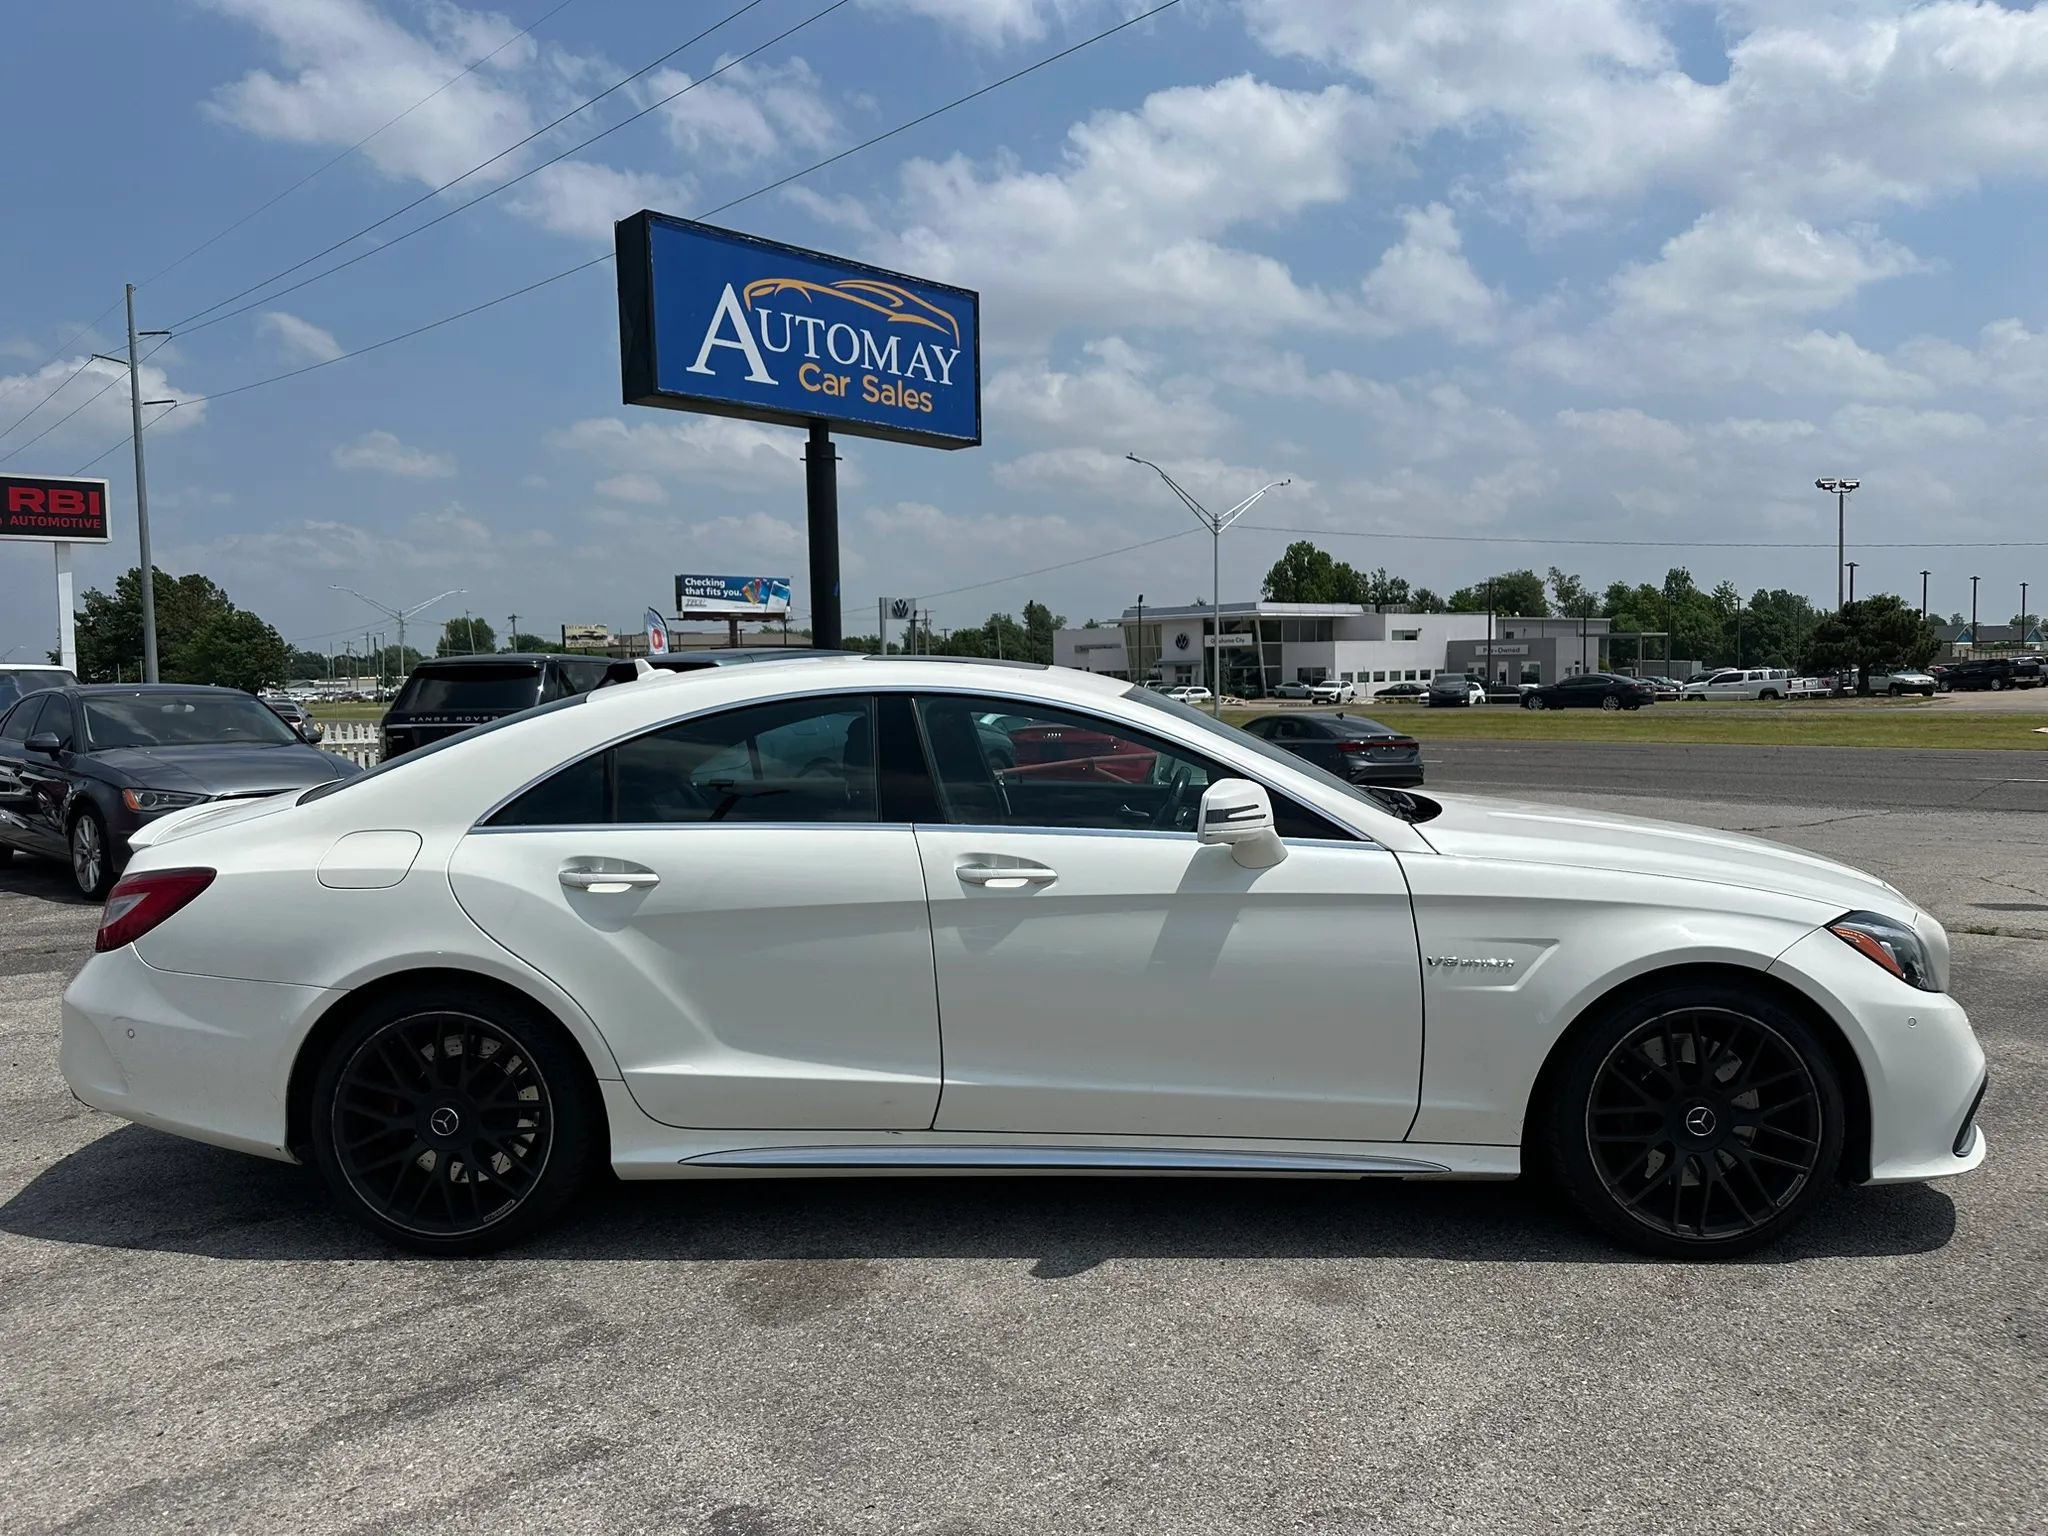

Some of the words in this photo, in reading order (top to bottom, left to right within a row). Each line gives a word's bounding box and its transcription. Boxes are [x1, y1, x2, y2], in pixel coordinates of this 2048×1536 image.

[686, 283, 960, 385] AUTOMAY
[798, 363, 851, 398] Car
[862, 375, 933, 414] Sales
[8, 487, 101, 516] RBI
[10, 515, 101, 529] AUTOMOTIVE
[685, 578, 726, 588] Checking
[685, 587, 704, 596] that
[706, 587, 721, 596] fits
[723, 588, 743, 598] you.
[1427, 956, 1458, 967] V8
